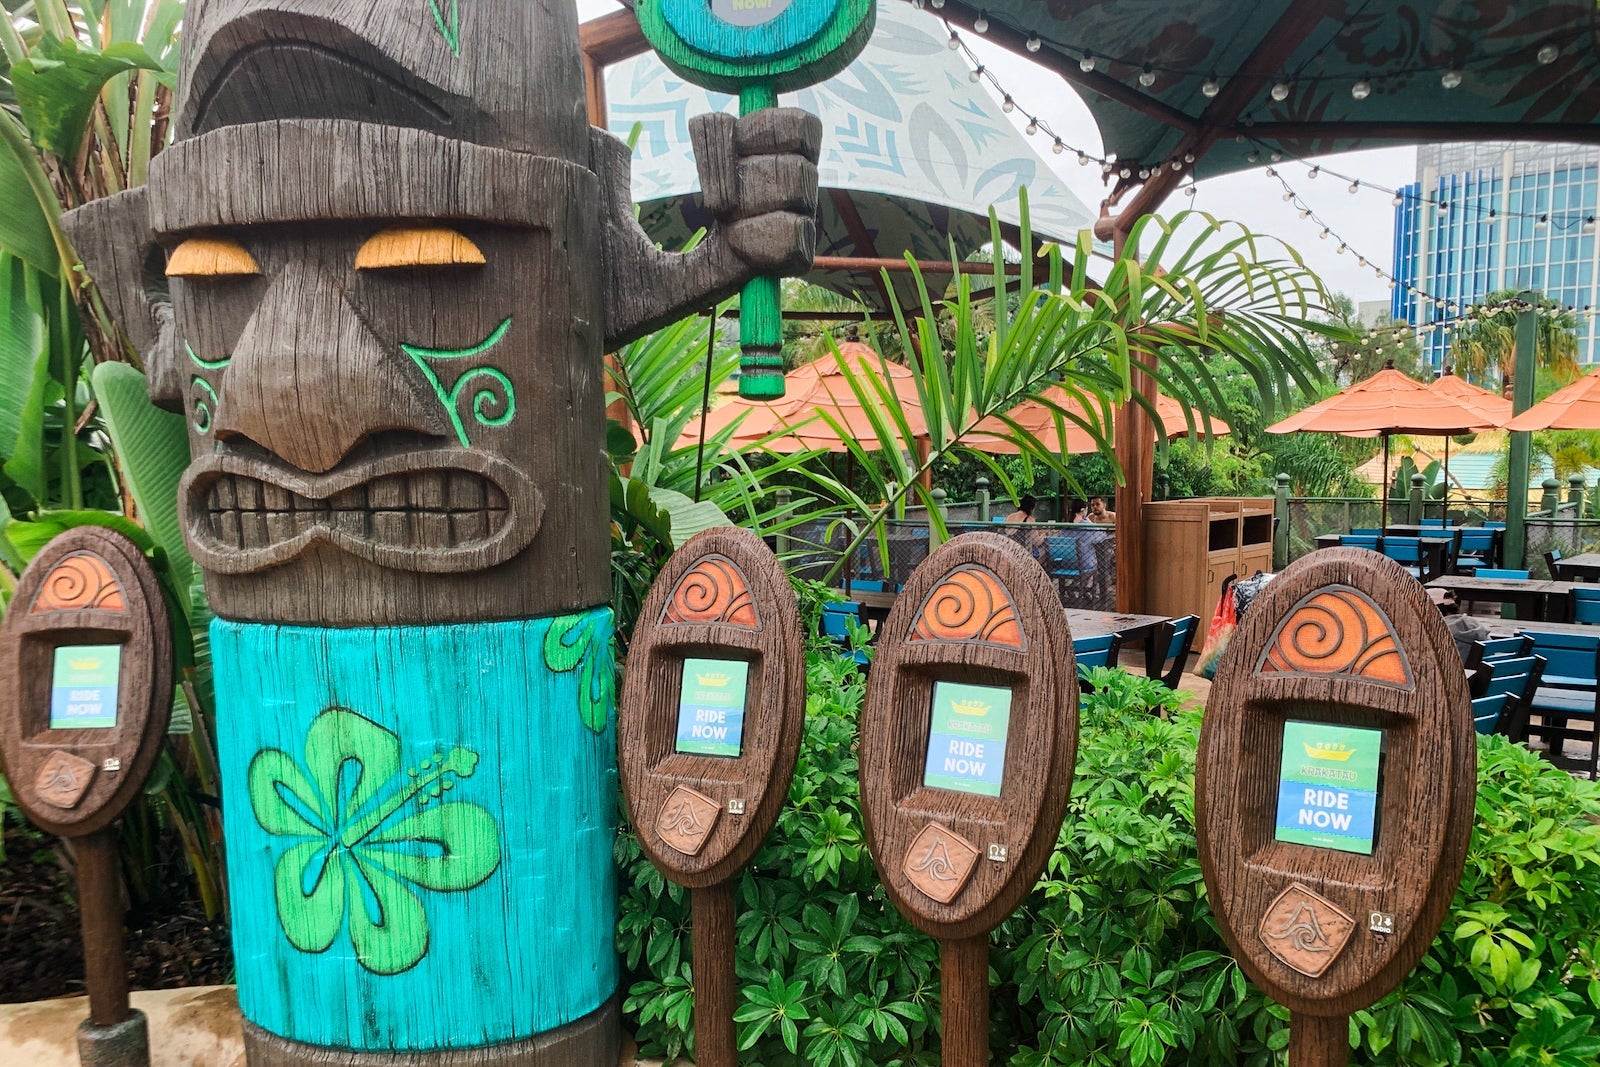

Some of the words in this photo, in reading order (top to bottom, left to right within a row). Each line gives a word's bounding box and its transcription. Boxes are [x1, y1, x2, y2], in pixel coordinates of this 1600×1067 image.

[732, 0, 773, 10] NOW!
[696, 709, 726, 724] RIDE
[691, 725, 728, 740] NOW
[949, 740, 985, 758] RIDE
[943, 757, 986, 777] NOW
[1300, 765, 1358, 782] KRAKATAU
[1303, 788, 1349, 811] RIDE
[1298, 808, 1352, 831] NOW
[1370, 925, 1391, 934] AUDIO
